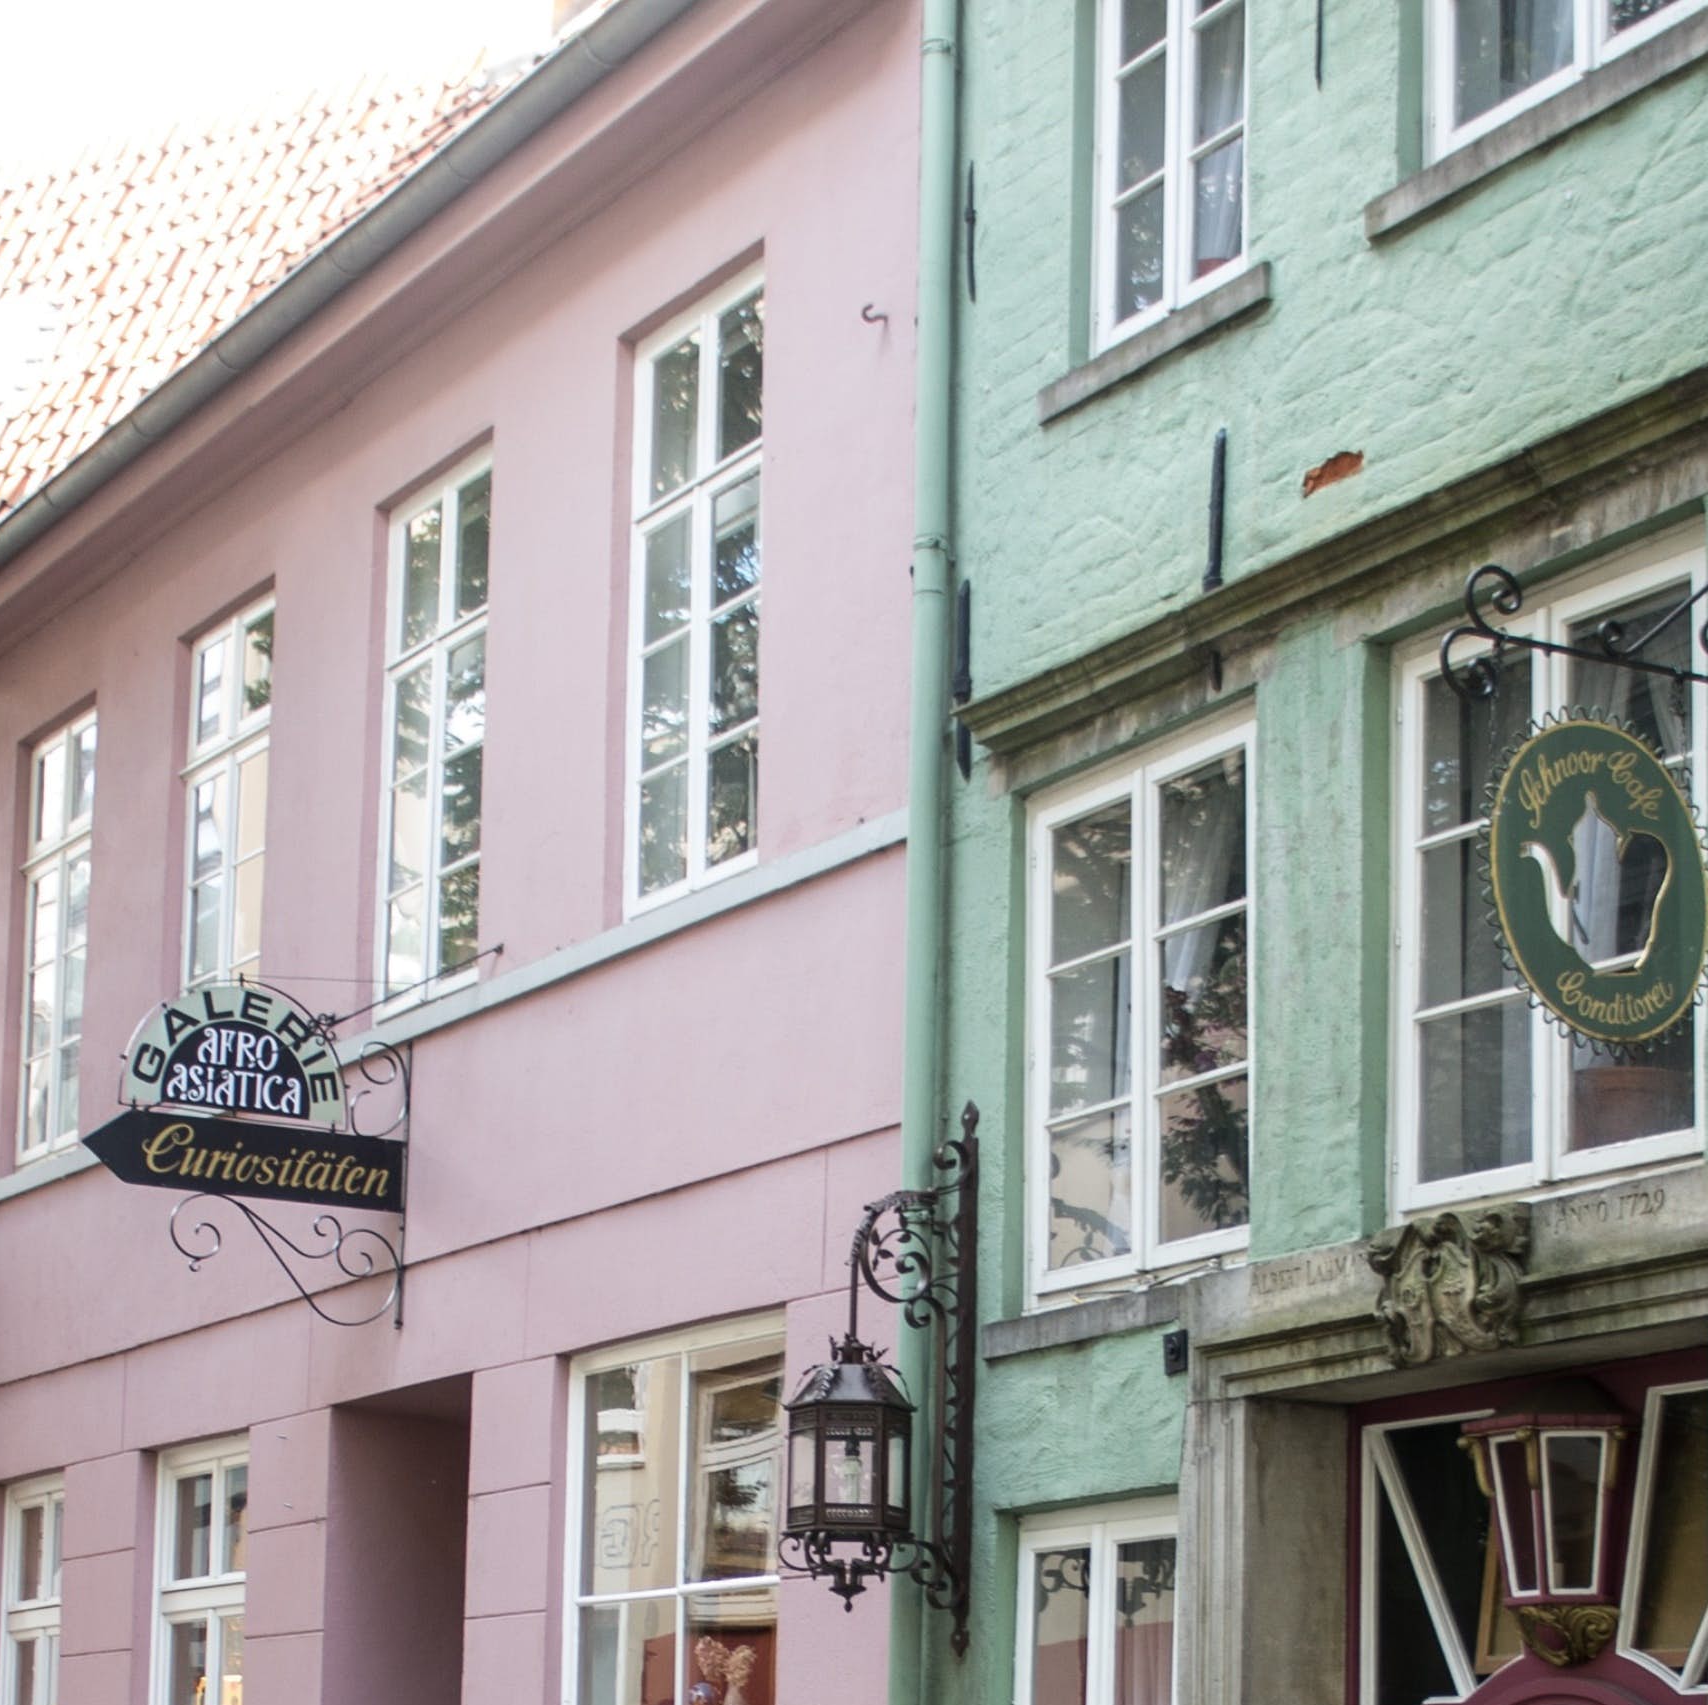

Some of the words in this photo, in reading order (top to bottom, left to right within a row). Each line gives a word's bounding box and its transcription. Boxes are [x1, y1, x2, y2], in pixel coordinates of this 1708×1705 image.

[1519, 750, 1605, 828] Schnoor
[1556, 970, 1675, 1025] Conditorei
[132, 990, 339, 1103] GALERIE
[197, 1026, 278, 1072] AFRO
[142, 1122, 389, 1198] Curiositäten
[1618, 1188, 1665, 1220] 1729
